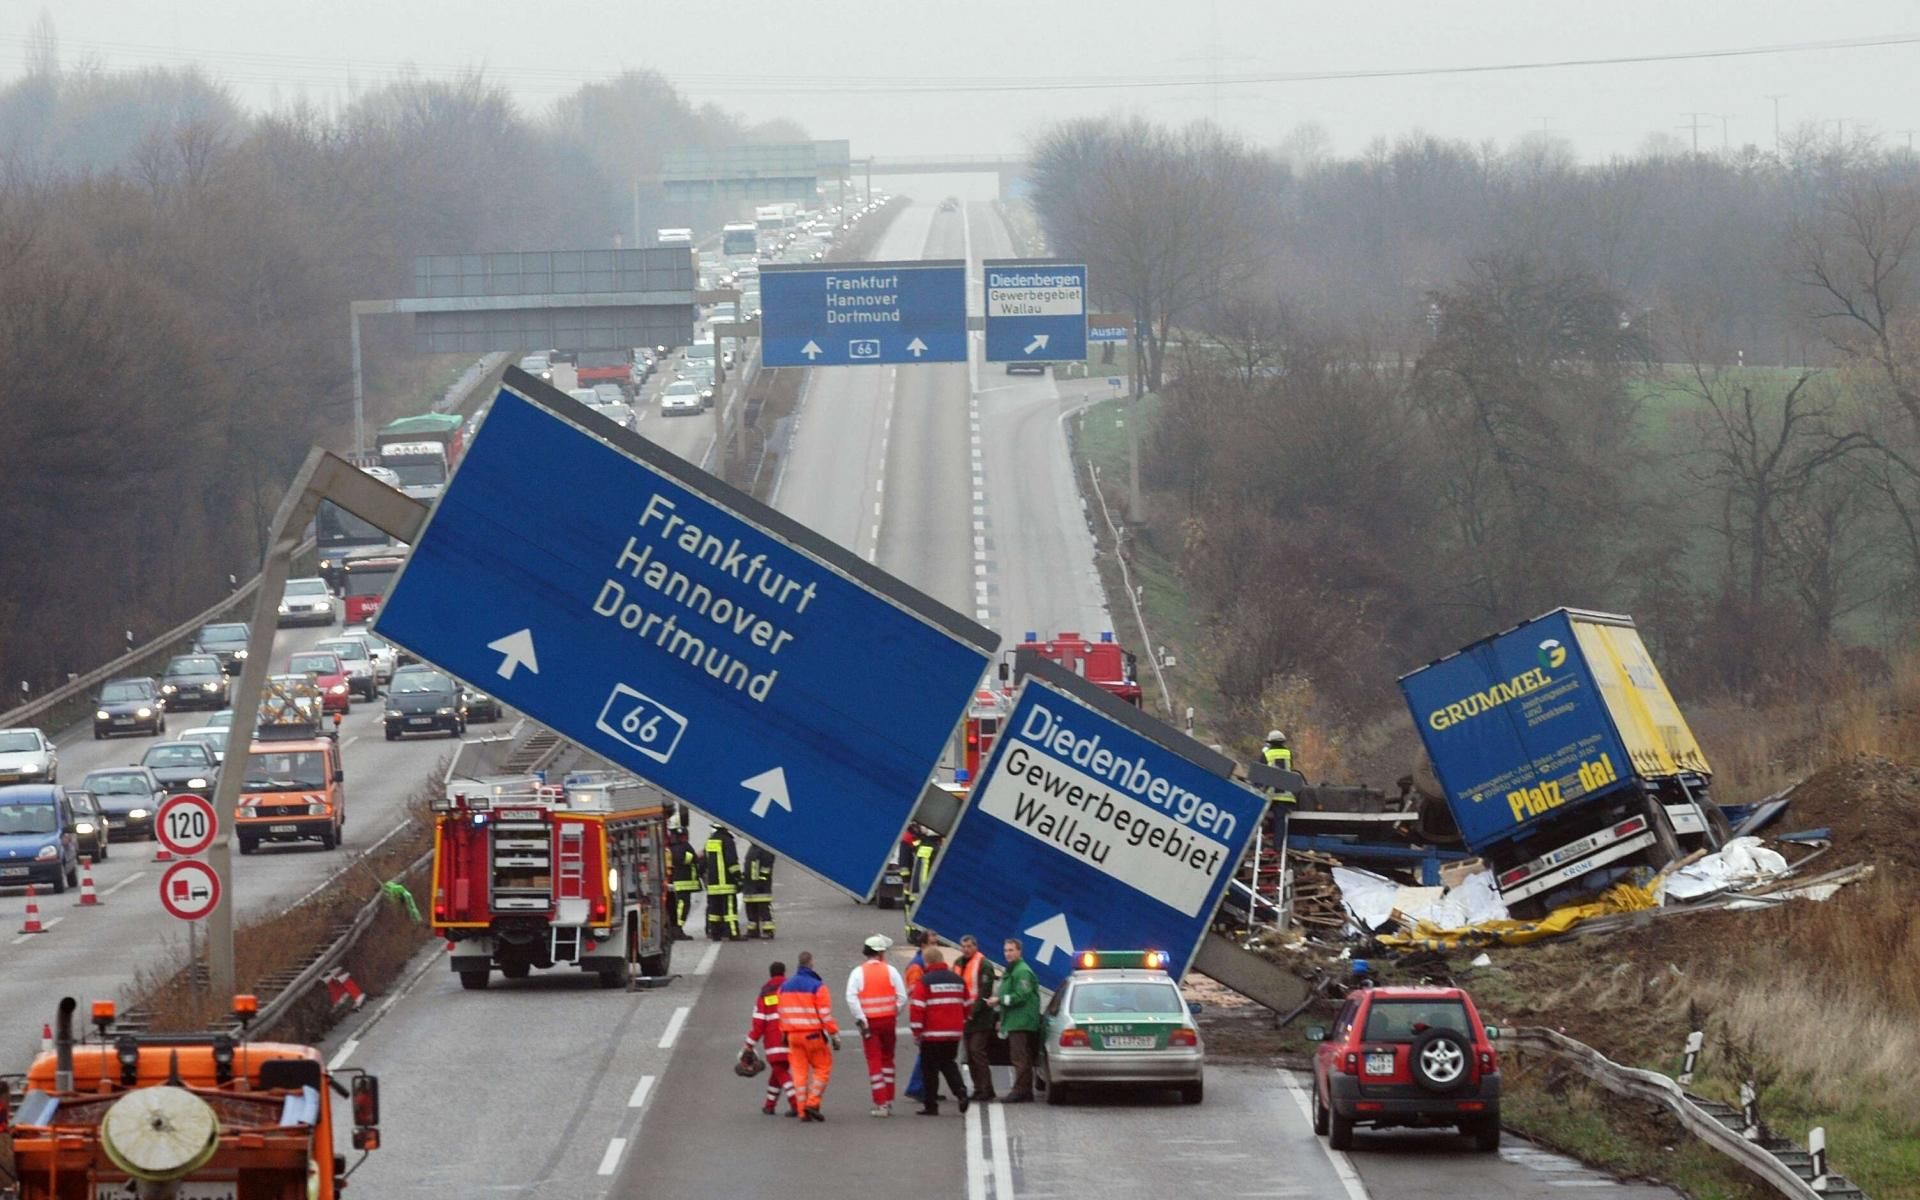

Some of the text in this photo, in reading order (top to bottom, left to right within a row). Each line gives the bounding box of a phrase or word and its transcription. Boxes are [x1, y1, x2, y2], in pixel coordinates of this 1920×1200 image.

[826, 276, 899, 289] Frankfurt
[990, 274, 1081, 288] Diedenbergen
[826, 294, 898, 306] Hannover
[991, 289, 1081, 302] Gewerbegebiet
[1001, 303, 1042, 315] Wallau
[826, 310, 900, 324] Dortmund
[857, 343, 872, 354] 66
[638, 494, 816, 613] Frankfurt
[616, 536, 794, 654] Hannover
[593, 579, 778, 702] Dortmund
[1429, 667, 1552, 730] GRUMMEL
[622, 706, 661, 742] 66
[1021, 704, 1236, 840] Diedenbergen
[1506, 780, 1567, 823] Platz
[1578, 752, 1617, 793] da!
[168, 811, 205, 839] 120
[1007, 748, 1219, 875] Gewerbegebiet
[1014, 792, 1111, 865] Wallau
[1562, 860, 1594, 878] KRONE
[1087, 1024, 1124, 1033] POLIZEI
